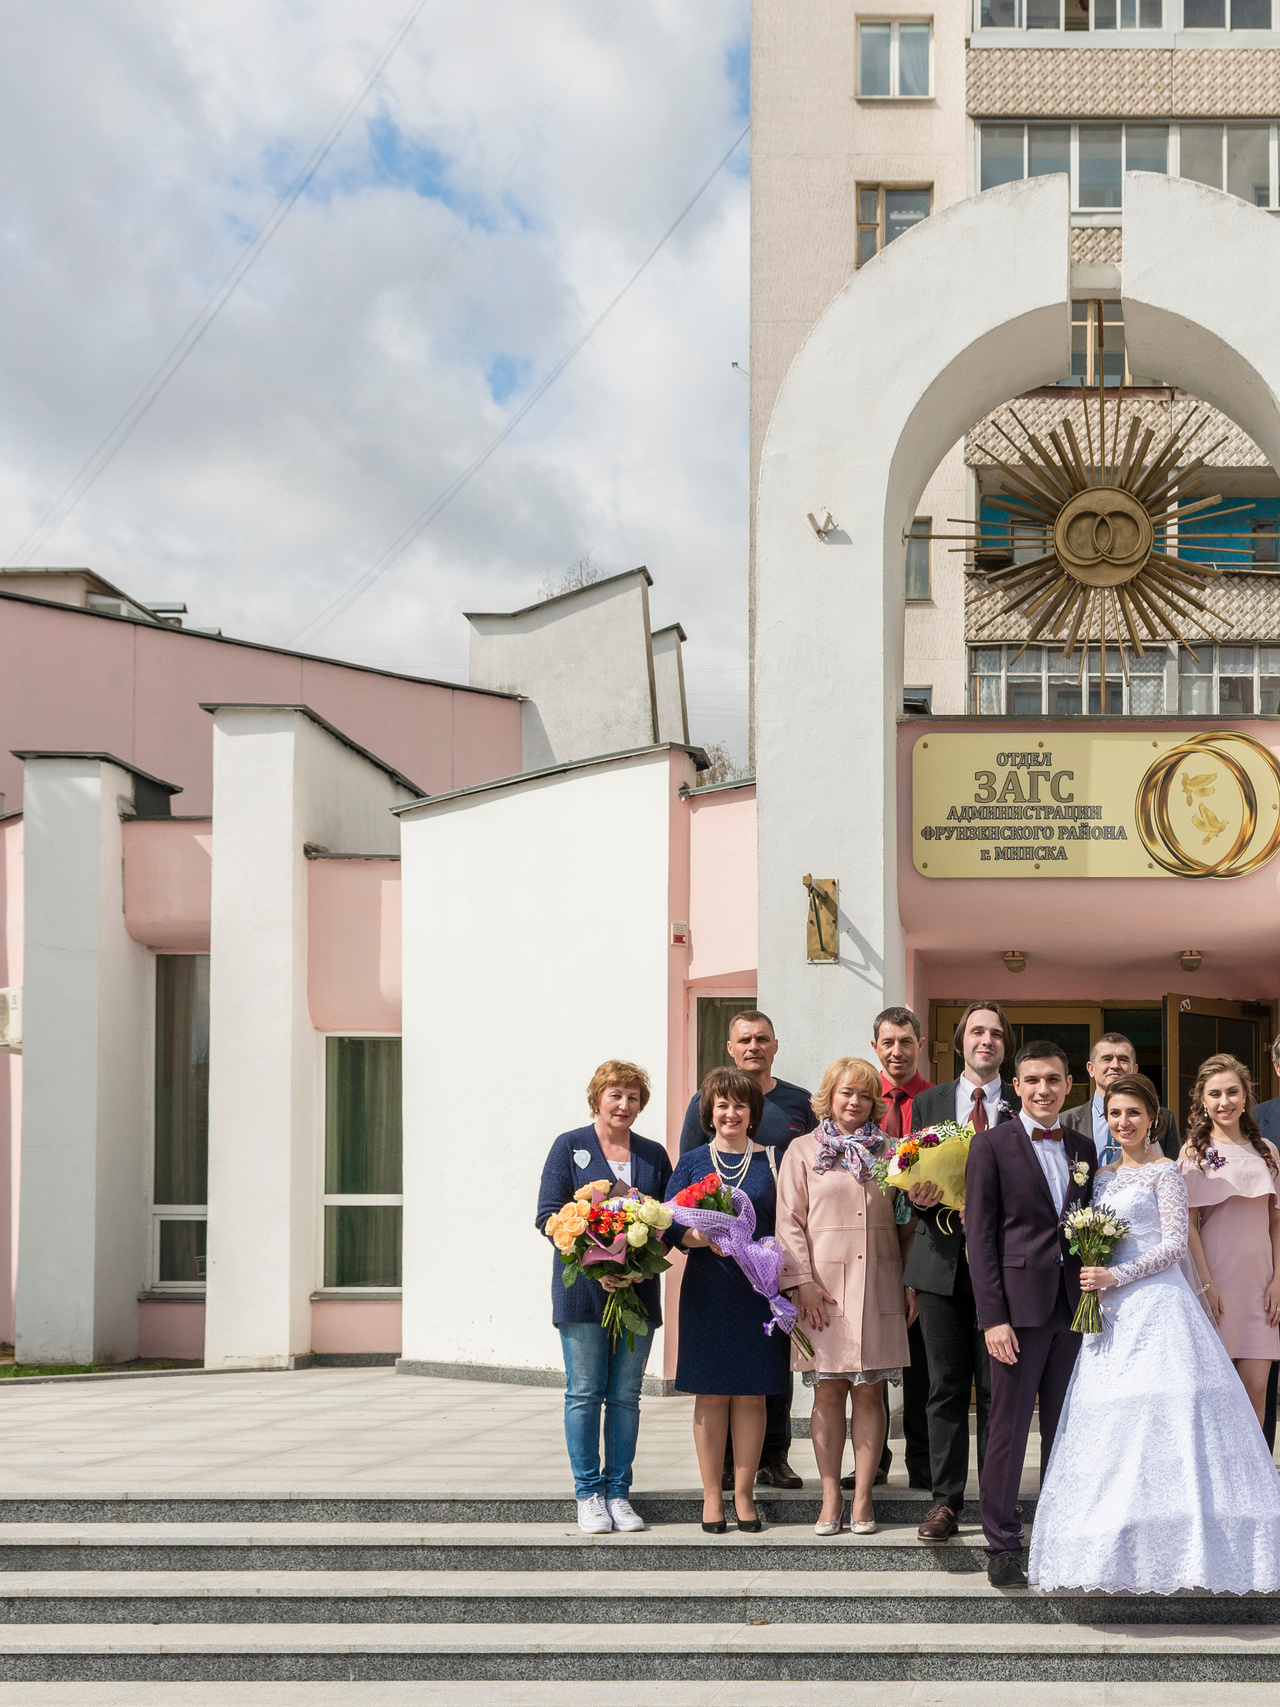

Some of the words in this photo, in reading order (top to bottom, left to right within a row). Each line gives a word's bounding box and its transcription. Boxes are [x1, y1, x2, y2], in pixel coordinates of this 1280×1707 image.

[996, 752, 1052, 769] ОТДЕЛ
[974, 770, 1075, 803] ЗАГС
[946, 805, 1103, 823] АДМИНИСТРАЦИИ
[920, 825, 1055, 841] ФРУНЗЕНСКОГО
[1057, 822, 1128, 841] РАЙОНА
[979, 849, 992, 860] г.
[994, 845, 1069, 860] МИНСКА
